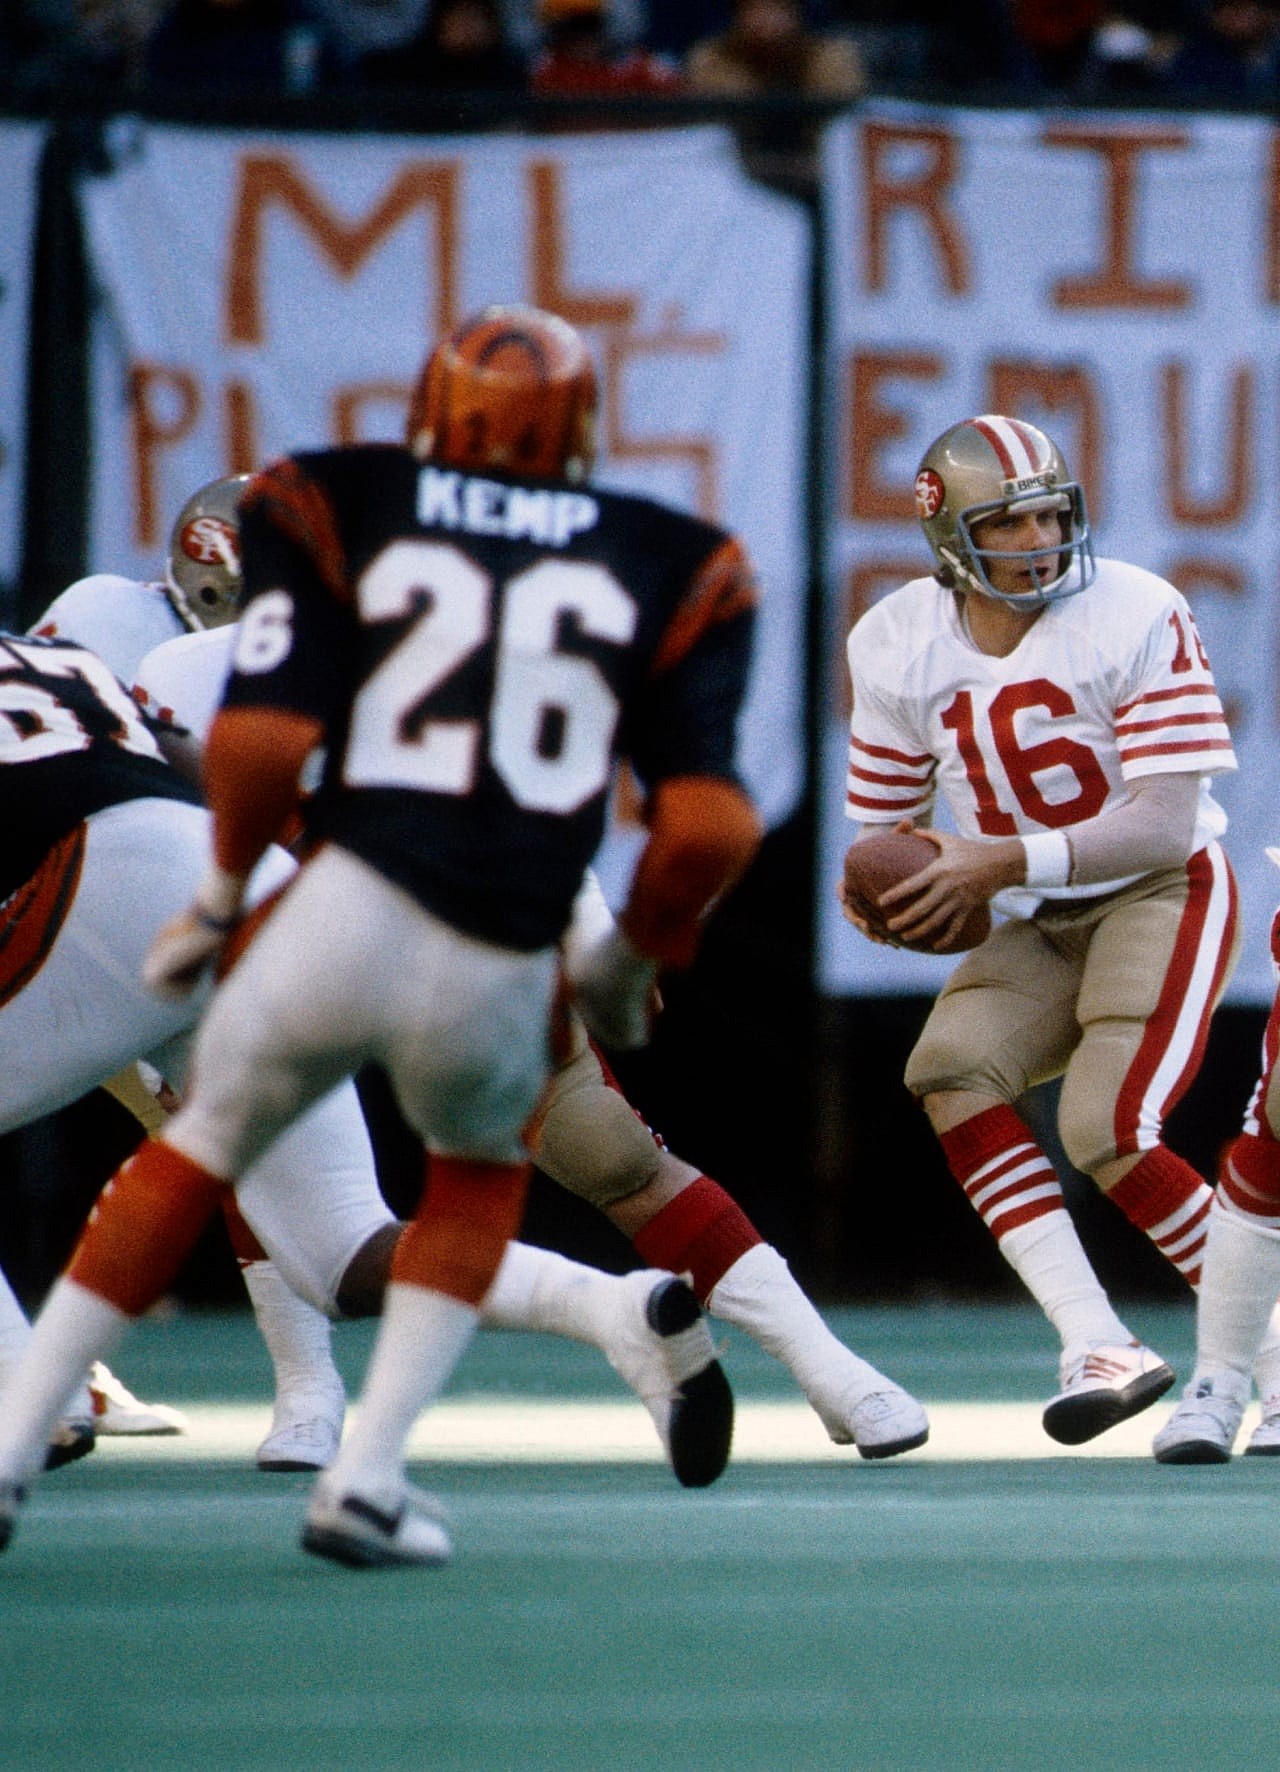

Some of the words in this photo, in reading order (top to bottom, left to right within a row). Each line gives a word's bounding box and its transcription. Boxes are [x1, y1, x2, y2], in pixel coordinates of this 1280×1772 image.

[416, 466, 599, 548] KEMP
[848, 350, 1100, 522] EM
[342, 537, 640, 817] 26
[939, 677, 1112, 838] 16
